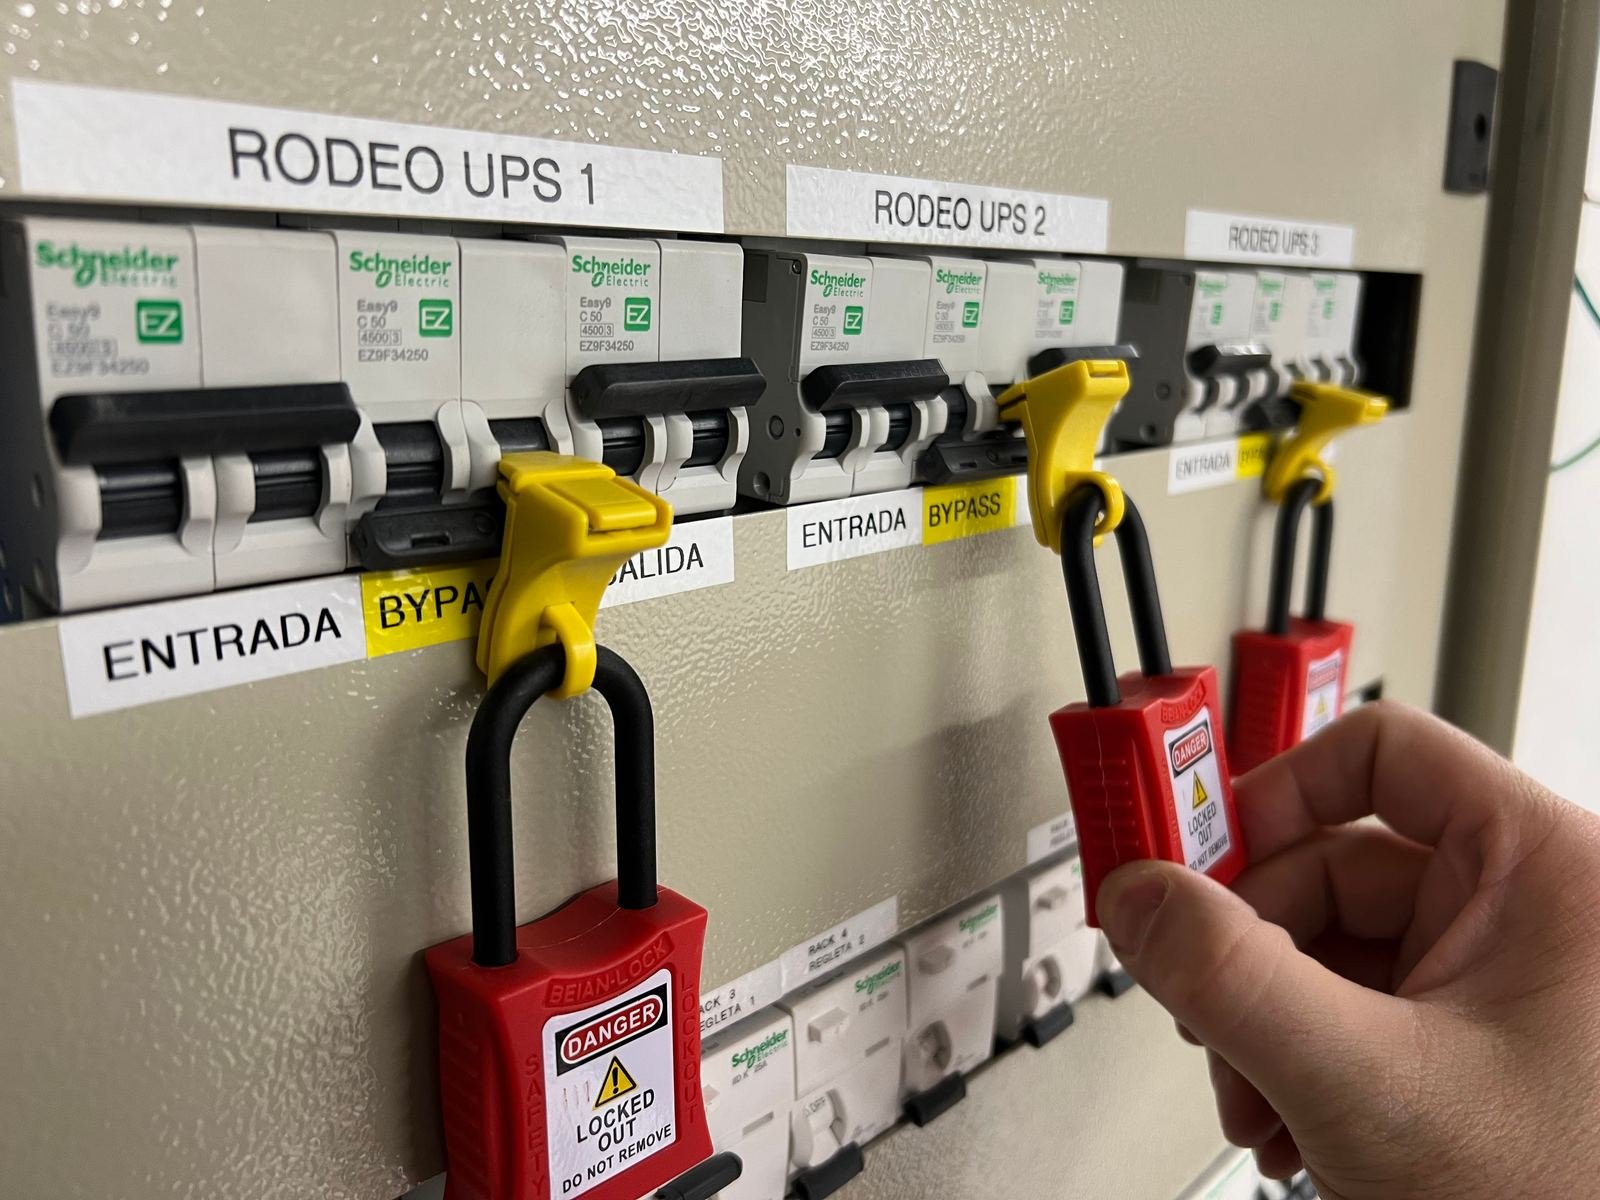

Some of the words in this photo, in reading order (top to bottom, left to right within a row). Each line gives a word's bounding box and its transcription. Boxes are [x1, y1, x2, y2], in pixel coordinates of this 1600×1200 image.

[229, 127, 444, 195] RODEO
[463, 151, 562, 203] UPS
[581, 163, 595, 205] 1
[875, 190, 971, 231] RODEO
[980, 201, 1027, 235] UPS
[1034, 206, 1046, 236] 2
[1229, 227, 1279, 254] RODEO
[1282, 231, 1308, 256] UPS
[36, 241, 178, 288] Schneider
[349, 250, 452, 288] Schneider
[395, 273, 449, 288] Electric
[572, 255, 651, 288] Schneider
[606, 275, 649, 287] Electric
[936, 268, 983, 294] Schneider
[810, 269, 866, 297] Schneider
[833, 287, 863, 298] Electric
[357, 299, 398, 317] Easy9
[580, 297, 611, 310] Easy9
[580, 311, 588, 322] C
[590, 311, 602, 322] 50
[813, 304, 836, 316] Easy9
[358, 348, 428, 362] EZ9F34250
[579, 340, 634, 352] EZ9F34250
[1175, 452, 1232, 480] ENTRADA
[929, 492, 1001, 528] BYPASS
[802, 507, 907, 548] ENTRADA
[608, 542, 704, 586] ALIDA
[379, 577, 494, 629] BYPA
[103, 607, 342, 682] ENTRADA
[1174, 732, 1207, 766] DANGER
[1188, 801, 1217, 836] LOCKED
[1198, 822, 1212, 846] OUT
[808, 935, 835, 955] RACK
[809, 942, 852, 971] REGLETA
[700, 996, 721, 1014] ACK
[729, 989, 736, 999] 3
[700, 1003, 741, 1032] EGLETA
[750, 995, 755, 1005] 1
[566, 1002, 656, 1058] DANGER
[731, 1029, 788, 1068] Schneider
[577, 1088, 655, 1144] LOCKED
[598, 1117, 637, 1152] OUT
[562, 1173, 582, 1194] DO
[587, 1156, 616, 1181] NOT
[618, 1123, 672, 1163] REMOVE
